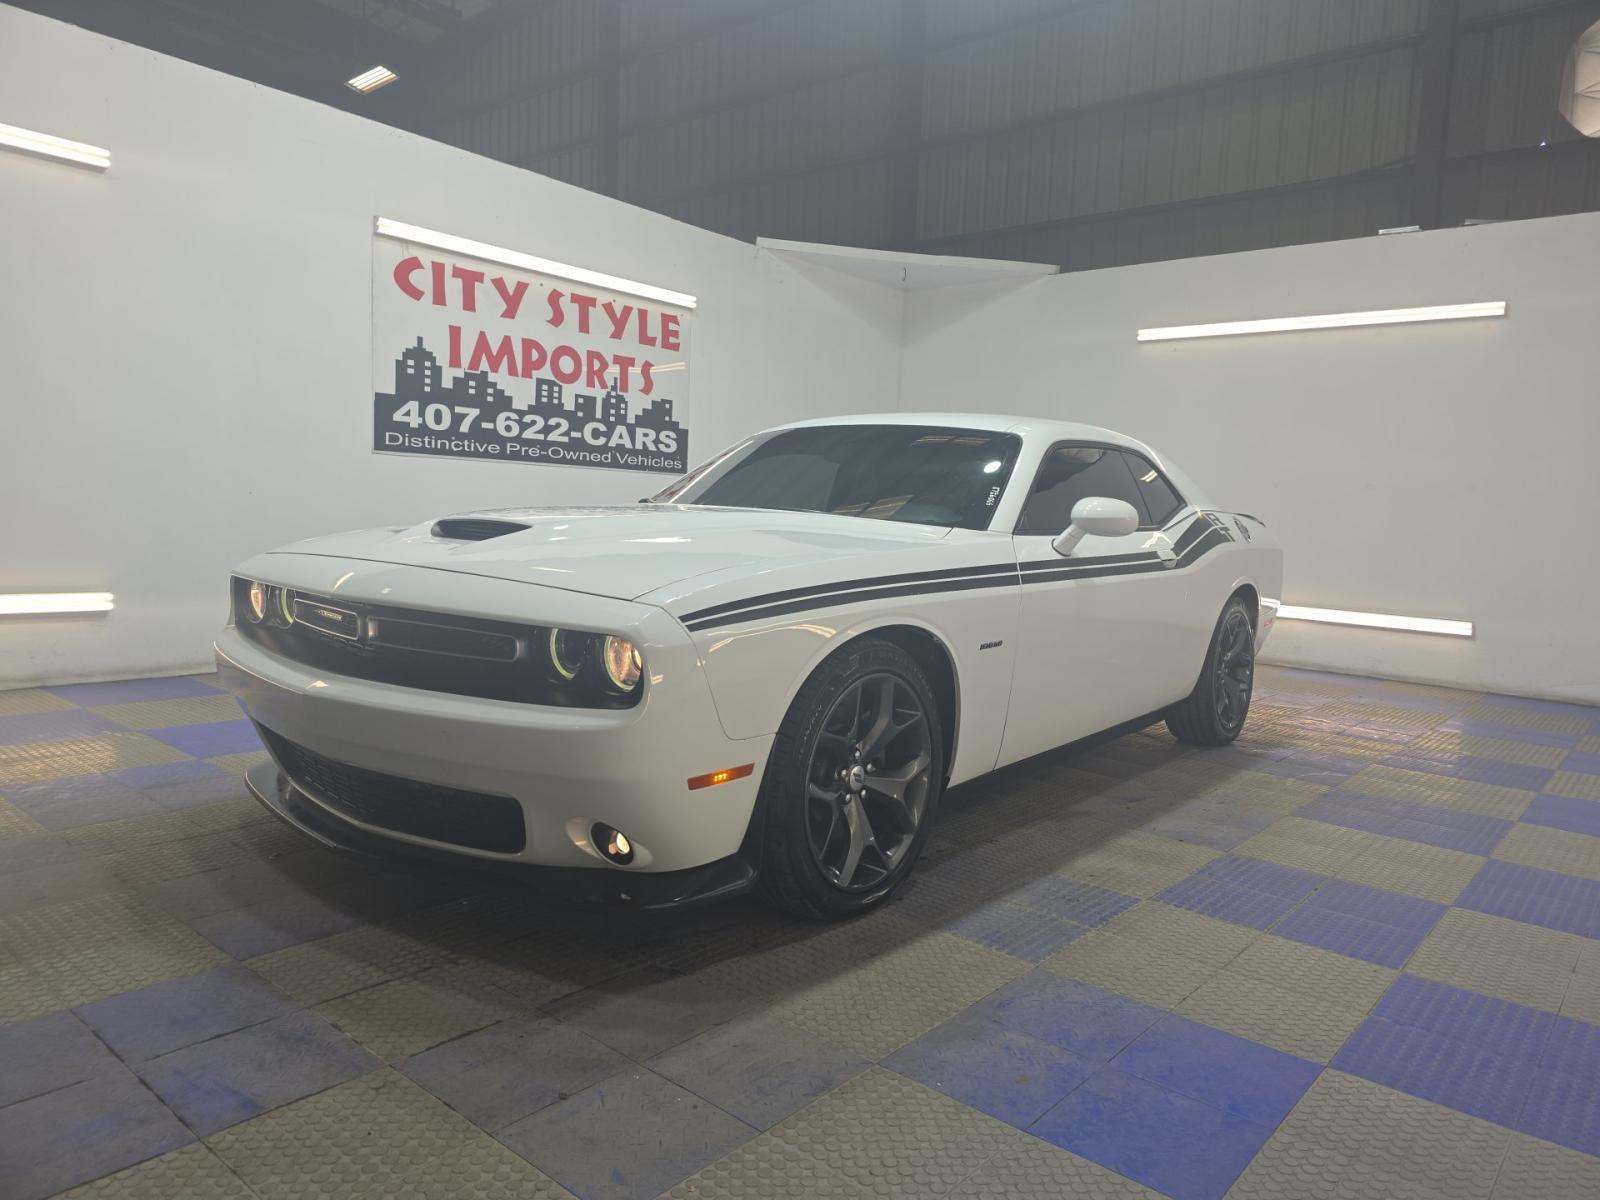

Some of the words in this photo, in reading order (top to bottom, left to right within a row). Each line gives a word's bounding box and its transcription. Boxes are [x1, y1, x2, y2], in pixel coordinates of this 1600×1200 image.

[393, 256, 530, 320] CITY
[546, 288, 681, 352] STYLE
[448, 324, 655, 396] IMPORTS
[385, 431, 501, 454] Distinctive
[506, 442, 612, 463] Pre-Owned
[616, 451, 683, 469] Vehicles
[392, 400, 678, 453] 407-622-CARS
